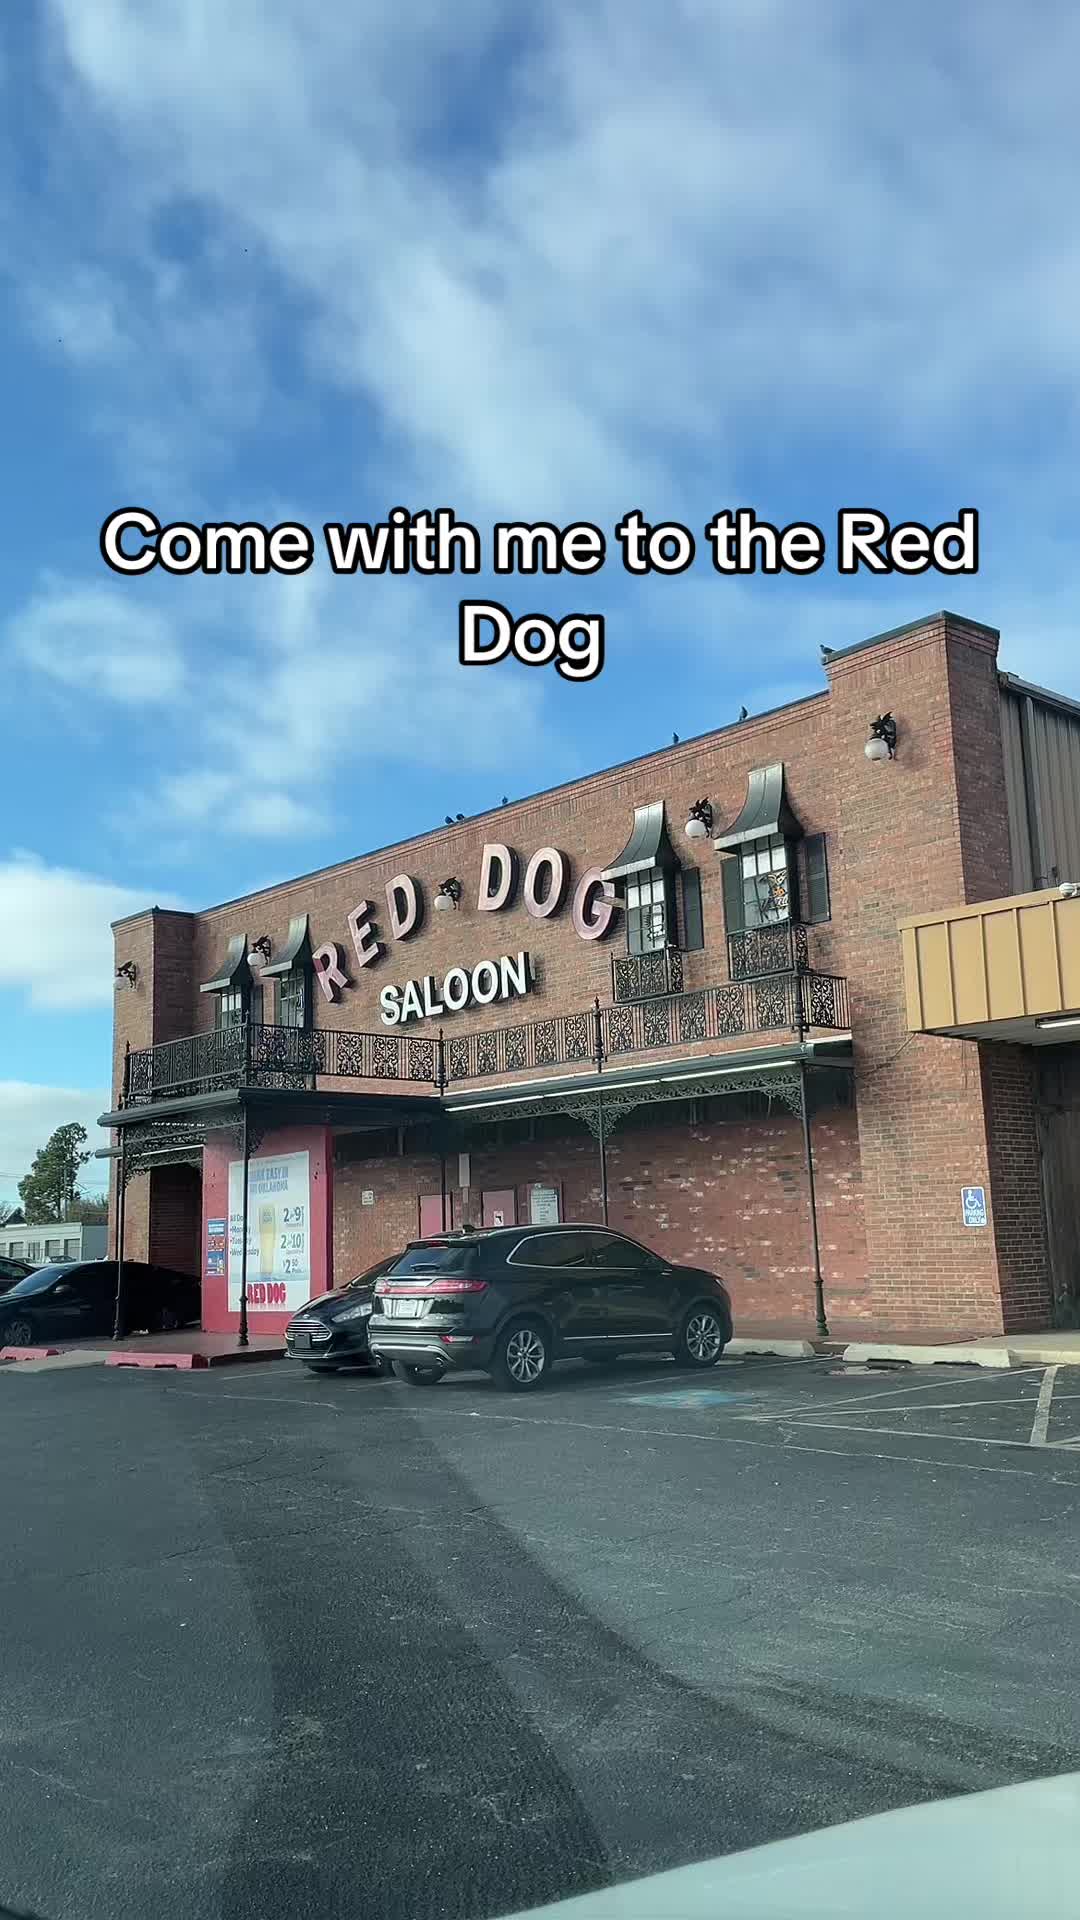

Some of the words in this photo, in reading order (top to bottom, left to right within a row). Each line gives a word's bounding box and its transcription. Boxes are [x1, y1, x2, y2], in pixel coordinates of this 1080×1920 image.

[312, 873, 422, 1002] RED
[477, 843, 617, 941] DOG
[379, 951, 531, 1026] SALOON
[247, 1283, 266, 1304] RED
[266, 1282, 286, 1304] DOG
